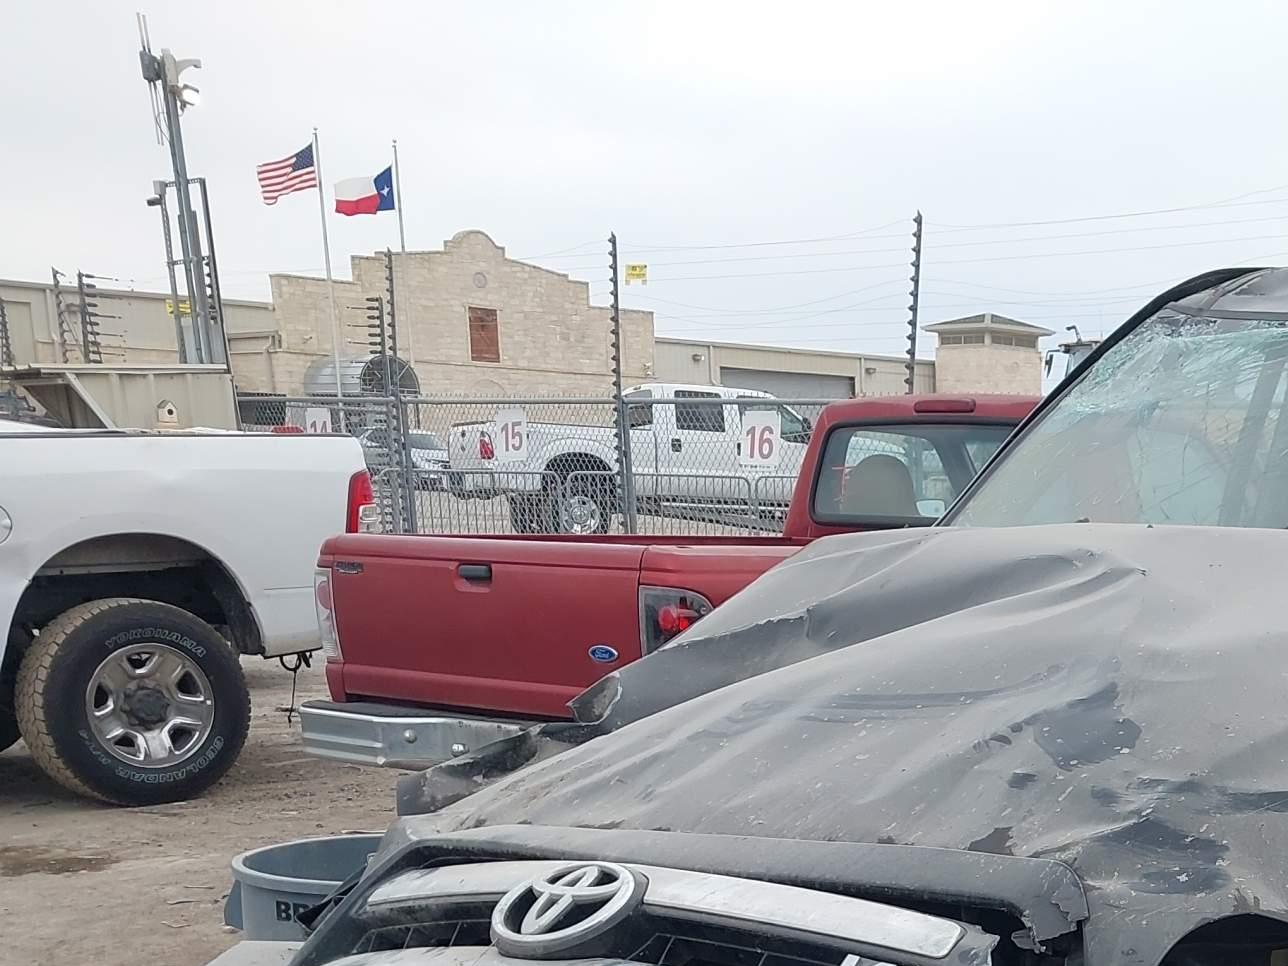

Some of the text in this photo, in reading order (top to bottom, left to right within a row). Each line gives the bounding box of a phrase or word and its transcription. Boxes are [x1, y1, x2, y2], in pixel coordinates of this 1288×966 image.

[500, 421, 523, 452] 15
[746, 425, 774, 460] 16
[105, 627, 207, 659] YOKOHAMA
[115, 735, 225, 783] GEOLANDAR
